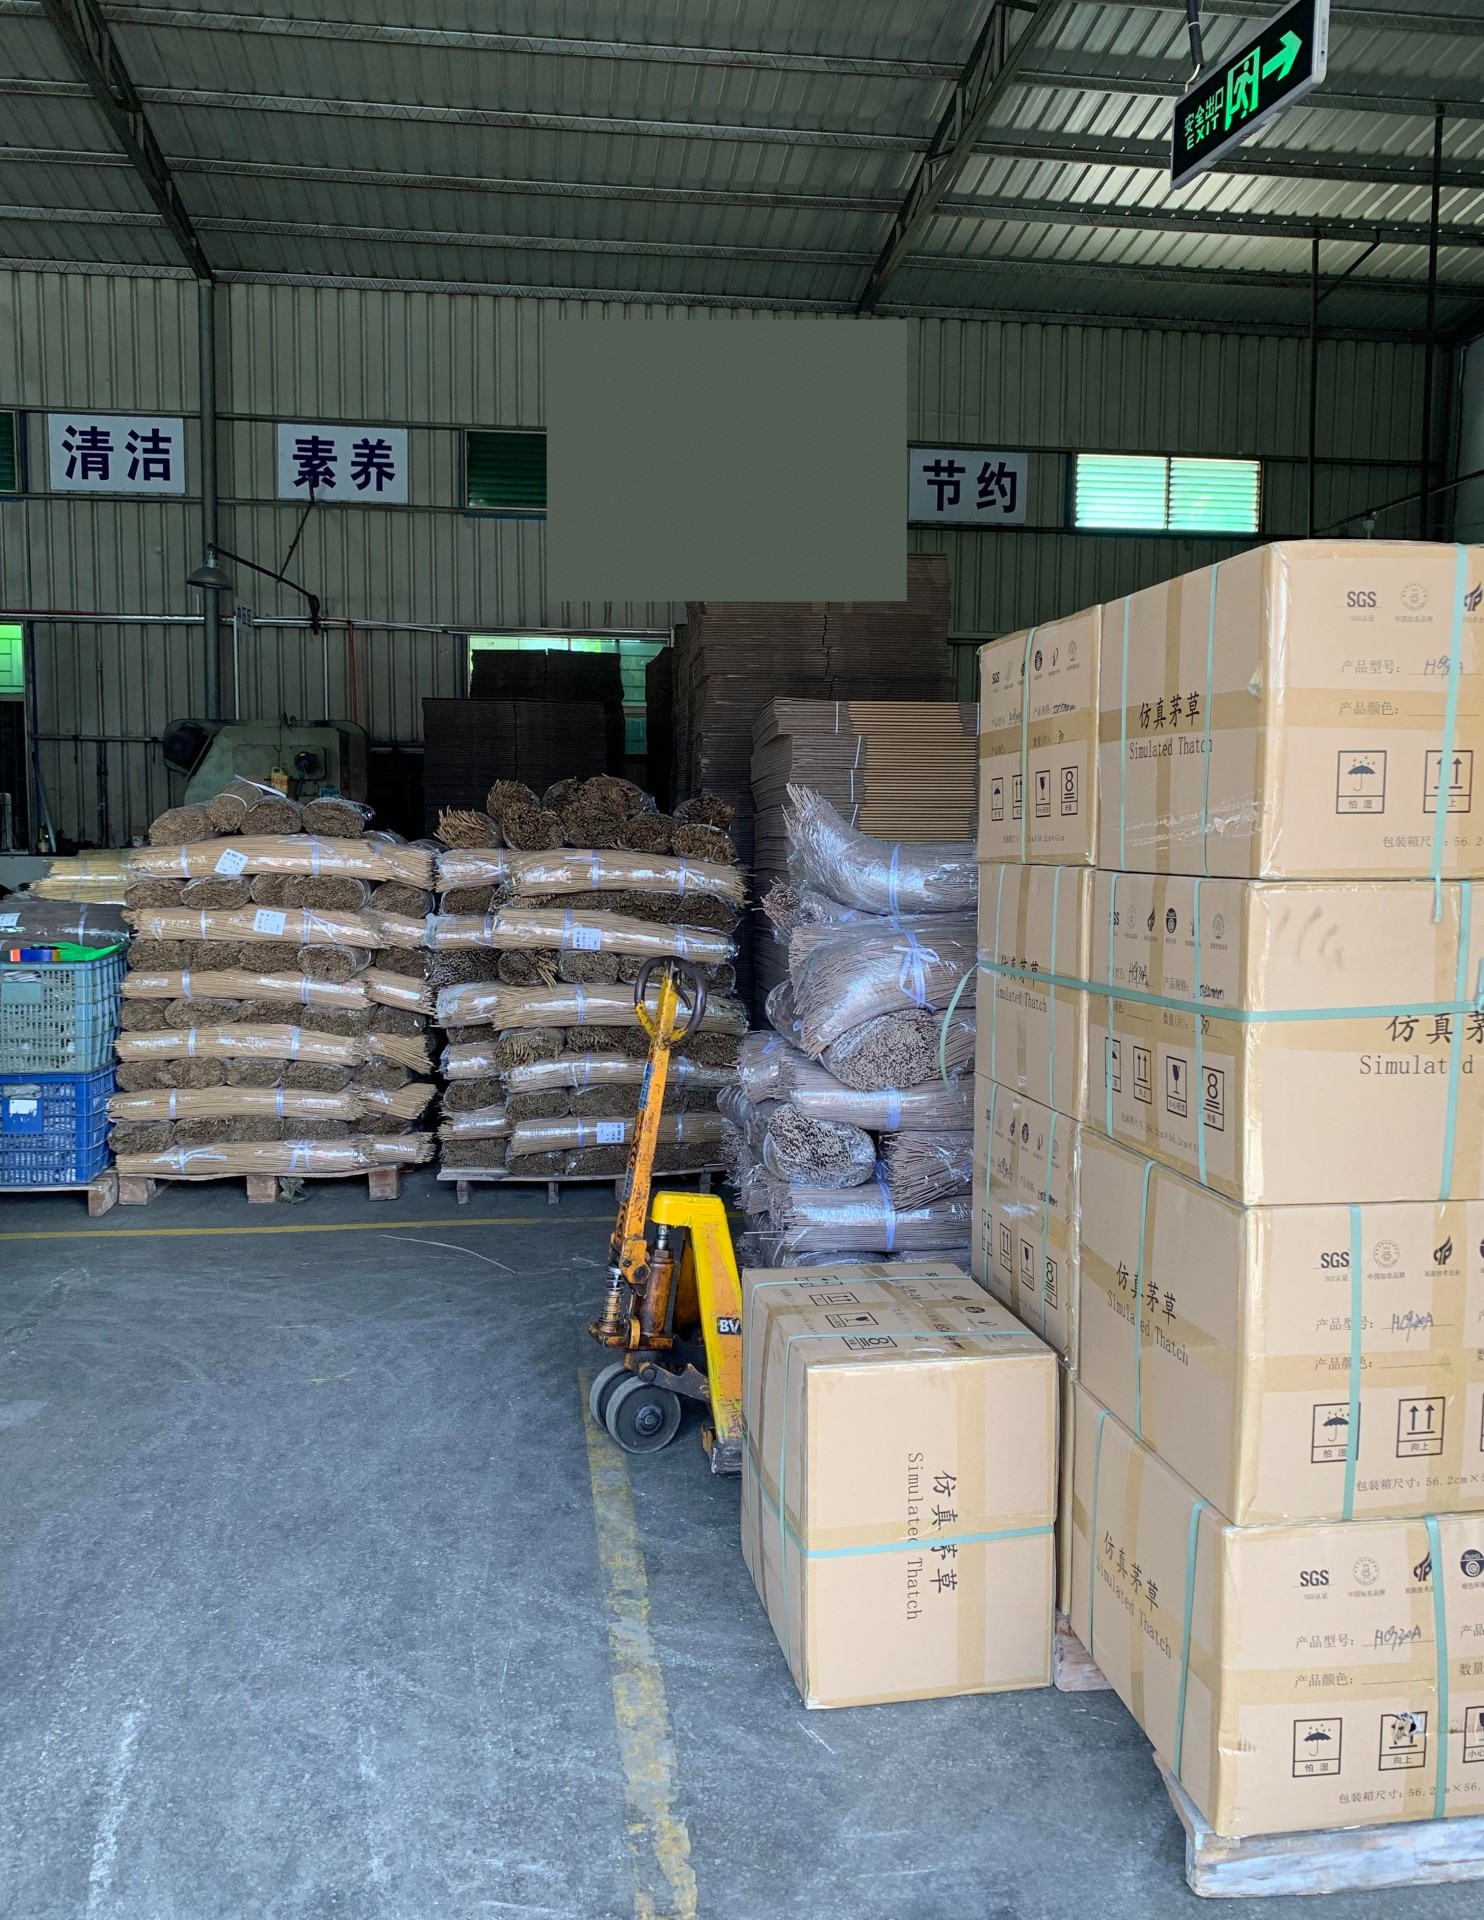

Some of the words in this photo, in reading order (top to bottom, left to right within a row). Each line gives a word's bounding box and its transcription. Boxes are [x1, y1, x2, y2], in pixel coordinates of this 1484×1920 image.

[1185, 87, 1224, 136] 安全出口
[1187, 114, 1219, 150] EXIT
[62, 425, 172, 481] 清洁
[292, 436, 395, 491] 素养
[923, 459, 1017, 513] 节约
[1347, 591, 1377, 608] SGS
[1139, 691, 1199, 730] 仿真茅草
[1129, 738, 1173, 760] Simulated
[996, 984, 1022, 1005] imulated
[1025, 992, 1048, 1013] Thatch
[1360, 1055, 1475, 1076] Simulatd
[1320, 1252, 1350, 1268] SGS
[1107, 1289, 1150, 1337] Simulaed
[1155, 1326, 1189, 1366] Thatch
[1410, 1442, 1430, 1452] 向上
[930, 1471, 958, 1594] 仿真茅草
[907, 1557, 923, 1620] Thatch
[1104, 1531, 1159, 1612] 仿真茅草
[1300, 1570, 1329, 1587] SGS
[1096, 1554, 1135, 1616] Simulated
[1139, 1608, 1172, 1660] Thatch
[1296, 1633, 1354, 1649] 产品型号：
[1294, 1672, 1354, 1688] 产品颜色：
[1393, 1755, 1412, 1765] 向上
